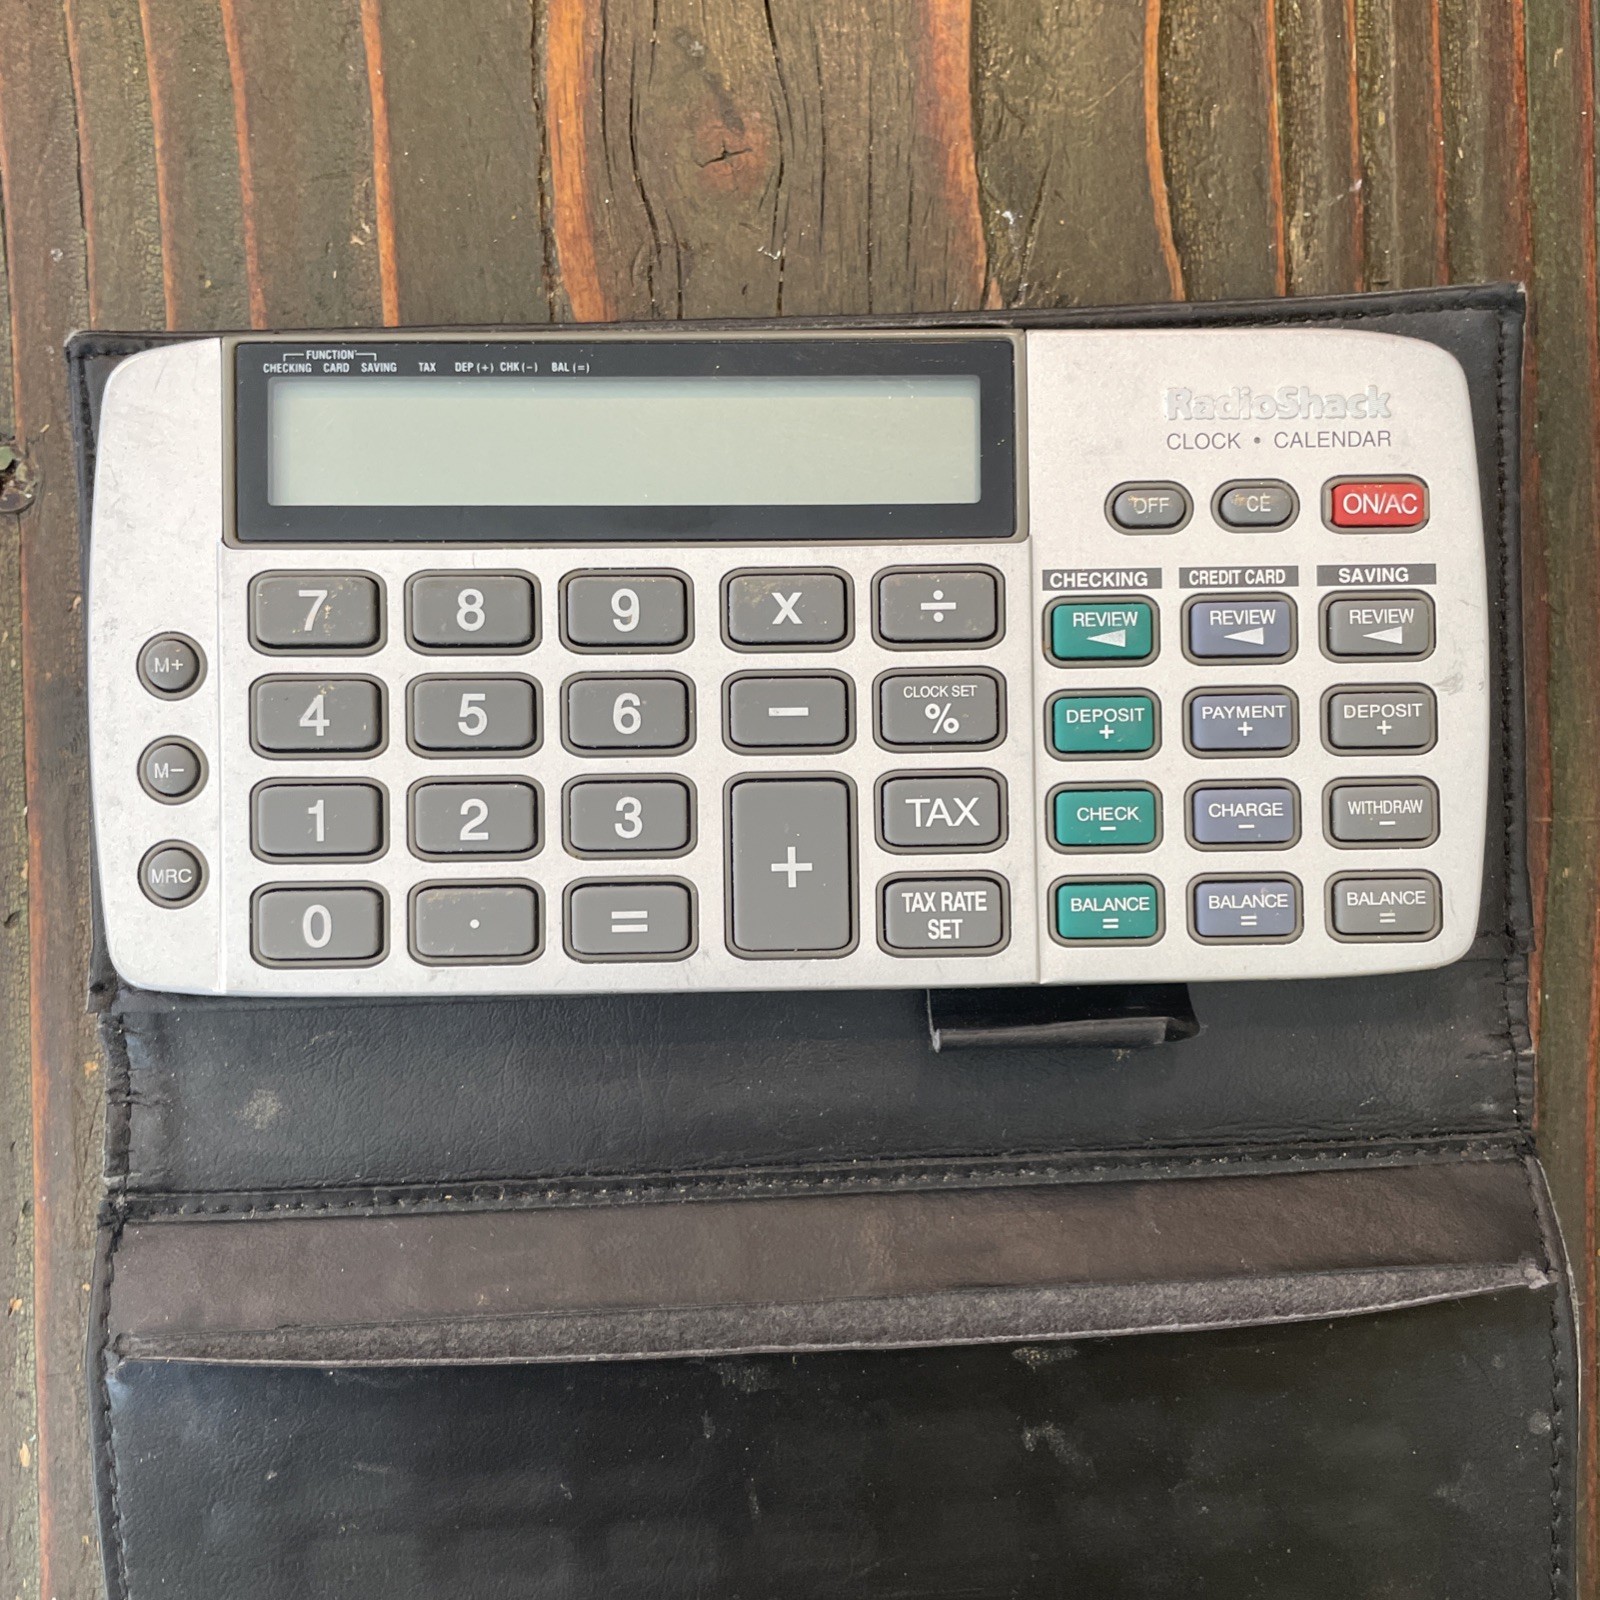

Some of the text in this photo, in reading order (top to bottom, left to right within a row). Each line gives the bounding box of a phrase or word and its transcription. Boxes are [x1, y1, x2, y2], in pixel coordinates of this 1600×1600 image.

[306, 350, 354, 360] FUNCTION
[263, 363, 312, 373] CHECKING
[323, 363, 350, 372] CARD
[361, 363, 397, 372] SAVING
[418, 362, 436, 373] TAX
[1166, 385, 1392, 420] RadioShack
[1167, 433, 1241, 450] CLOCK
[1274, 431, 1391, 448] CALENDAR
[1134, 498, 1170, 514] OFF
[1247, 495, 1271, 512] CE
[1342, 492, 1418, 515] ON/AC
[1049, 572, 1148, 588] CHECKING
[1189, 569, 1286, 586] CREDIT CARD
[1338, 567, 1409, 583] SAVING
[298, 590, 328, 631] 7
[456, 588, 486, 631] 8
[611, 588, 640, 632] 9
[1209, 609, 1276, 626] REVIEW
[1349, 608, 1414, 624] REVIEW
[1072, 611, 1138, 627] REVIEW
[154, 658, 183, 672] M+
[903, 684, 977, 699] CLOCK SET
[299, 694, 330, 736] 4
[458, 693, 487, 736] 5
[612, 692, 641, 734] 6
[925, 703, 959, 734] %
[1066, 708, 1145, 723] DEPOSIT
[1202, 705, 1286, 720] PAYMENT
[1343, 703, 1423, 718] DEPOSIT
[905, 797, 980, 828] TAX
[1076, 806, 1140, 822] CHECK
[1208, 802, 1284, 817] CHARGE
[1348, 799, 1423, 815] WITHDRAW
[307, 799, 326, 842] 1
[459, 799, 489, 841] 2
[614, 797, 643, 839] 3
[151, 868, 193, 883] MRC
[901, 890, 987, 912] TAX RATE
[1070, 896, 1150, 912] BALANCE
[1208, 893, 1288, 909] BALANCE
[1346, 891, 1426, 906] BALANCE
[302, 904, 332, 949] 0
[927, 919, 963, 940] SET
